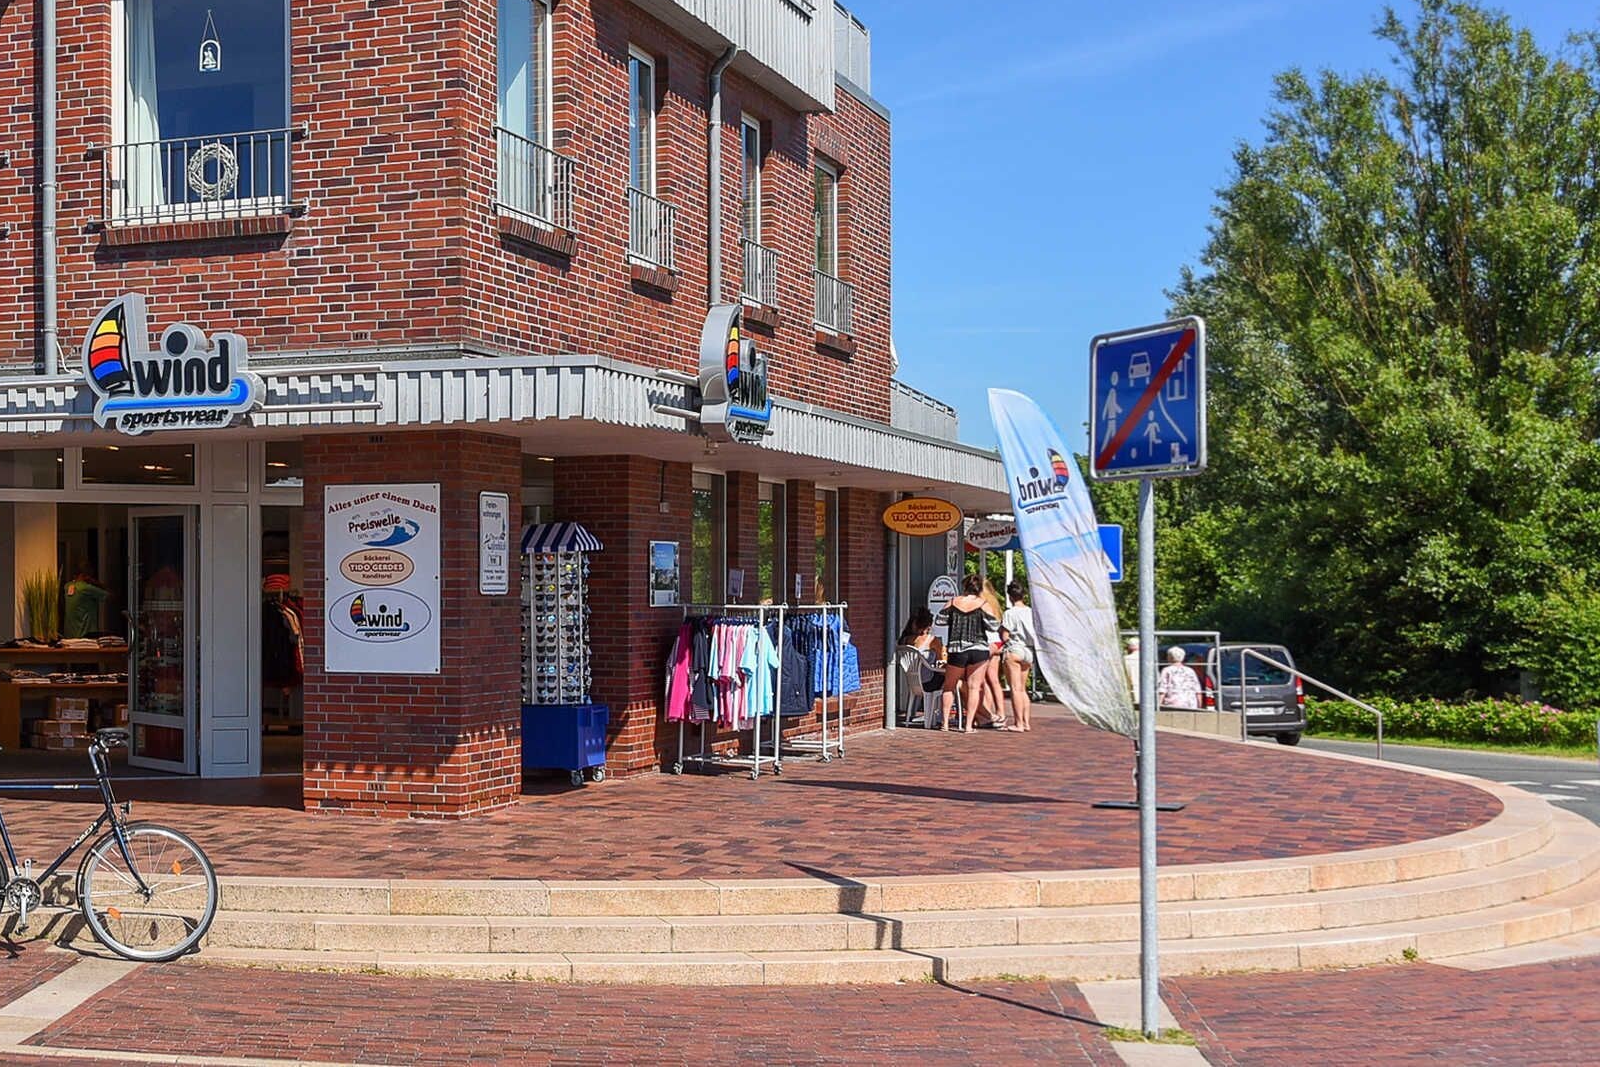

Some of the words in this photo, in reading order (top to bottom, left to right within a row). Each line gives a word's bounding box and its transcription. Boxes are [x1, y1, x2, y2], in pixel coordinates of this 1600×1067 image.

[132, 331, 230, 396] wind
[121, 409, 229, 430] sportswear
[328, 501, 352, 514] Alles
[353, 492, 381, 506] unter
[381, 492, 411, 506] einem
[412, 499, 437, 513] Dach
[348, 513, 402, 533] Preiswelle
[892, 512, 915, 521] TIDO
[916, 512, 952, 521] GERDES
[349, 563, 371, 572] TIDO
[372, 563, 405, 572] GERDES
[366, 604, 403, 627] wind
